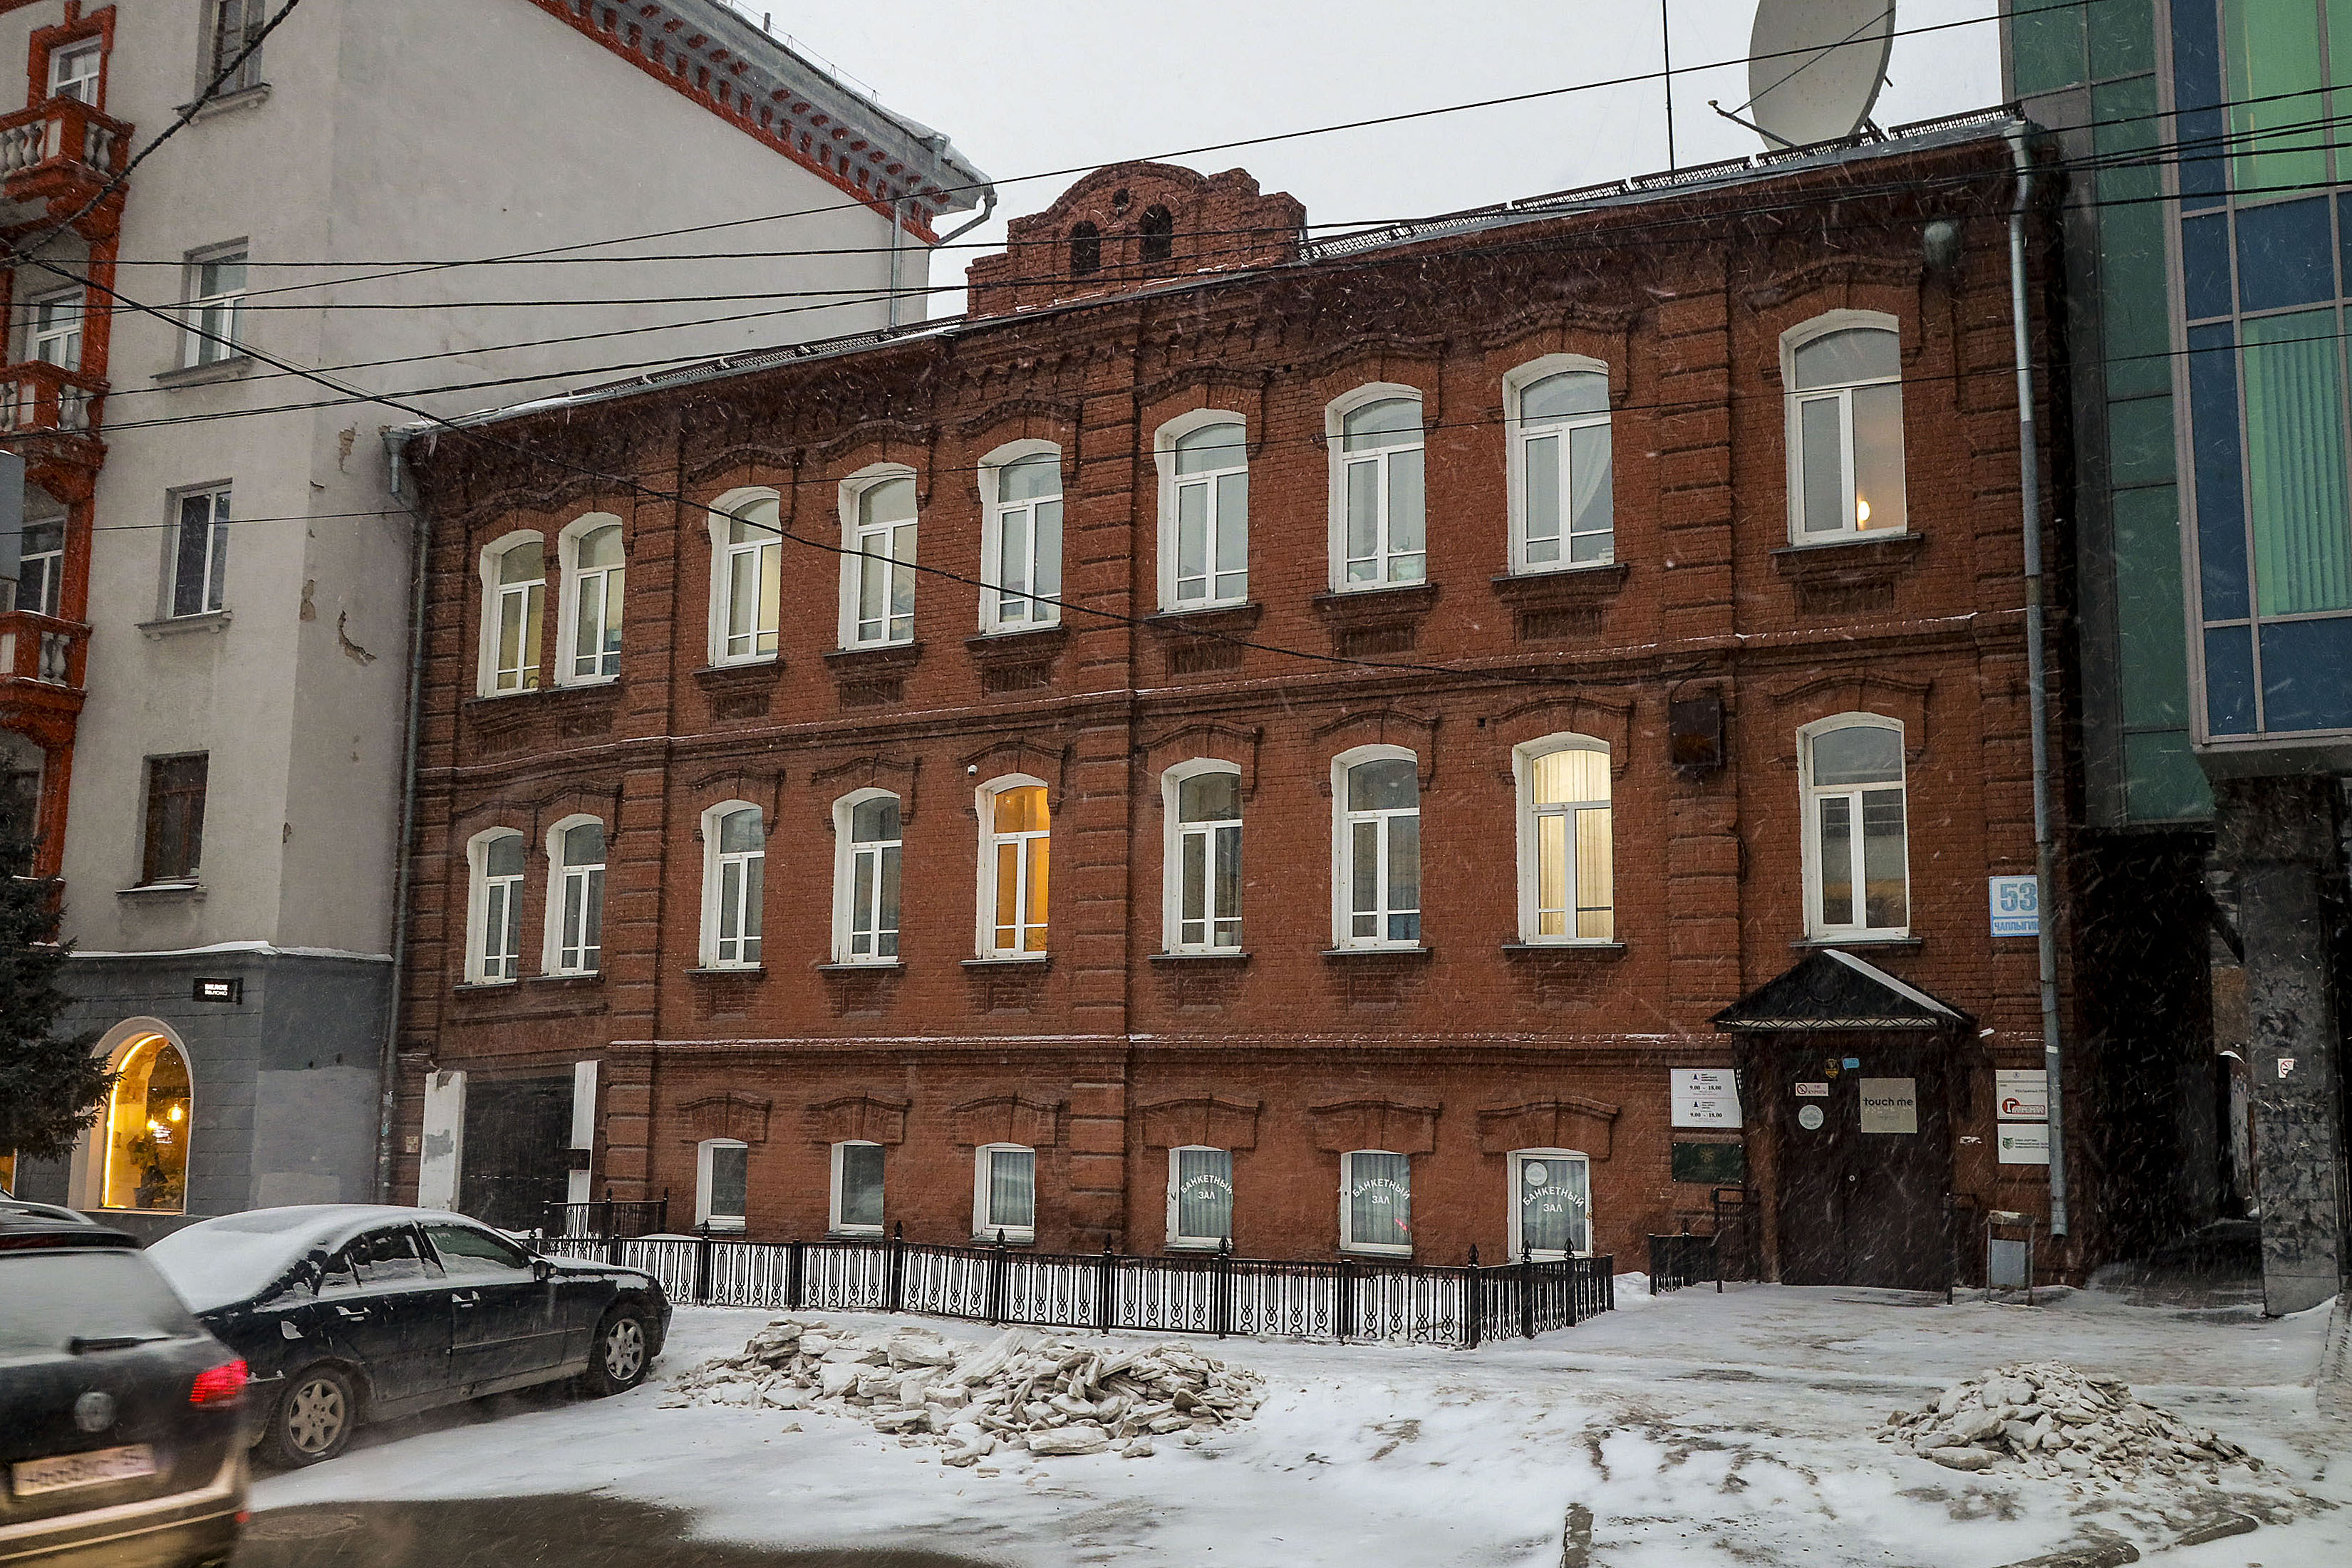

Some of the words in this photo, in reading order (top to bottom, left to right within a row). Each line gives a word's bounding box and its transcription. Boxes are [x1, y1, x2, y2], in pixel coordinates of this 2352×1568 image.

[2000, 882, 2037, 911] 53
[1863, 1097, 1895, 1106] touch
[1352, 1178, 1410, 1200] БАНКЕТНЫЙ
[1198, 1191, 1216, 1200] ЗАЛ
[1372, 1195, 1390, 1204] ЗАЛ
[1523, 1186, 1585, 1208] БАНКЕТНЫЙ
[1543, 1203, 1563, 1213] ЗАЛ
